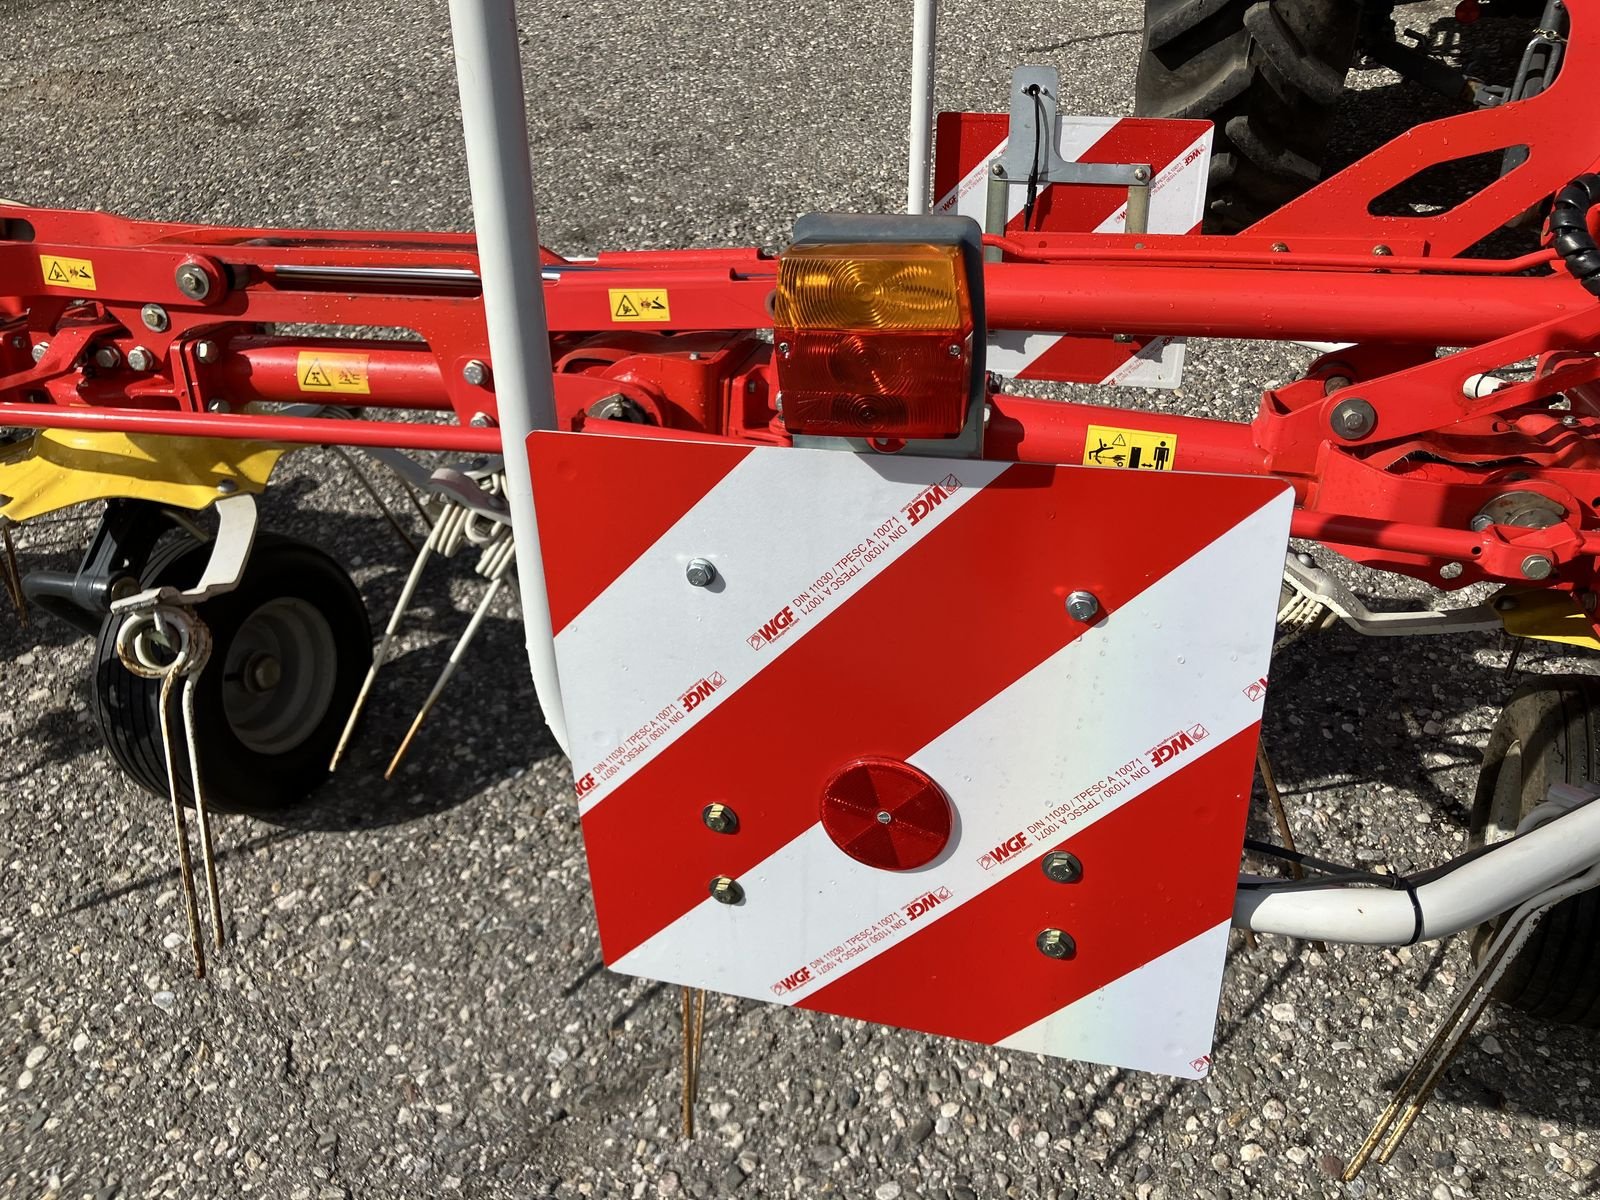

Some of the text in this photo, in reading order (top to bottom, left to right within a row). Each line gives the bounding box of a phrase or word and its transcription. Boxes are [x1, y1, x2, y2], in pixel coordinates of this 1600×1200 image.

[1184, 149, 1201, 166] WGF
[907, 485, 948, 526] WGF
[888, 525, 907, 542] DIN
[864, 541, 889, 562] 11030
[758, 606, 793, 642] WGF
[792, 592, 810, 607] DIN
[809, 572, 833, 593] 11030
[835, 544, 866, 570] TPESC
[866, 538, 875, 547] A
[874, 516, 899, 539] 10071
[830, 565, 862, 590] TPESC
[823, 587, 831, 595] A
[800, 594, 824, 615] 10071
[683, 680, 716, 712] WGF
[668, 711, 684, 725] DIN
[593, 762, 608, 774] DIN
[606, 746, 625, 763] 11030
[626, 725, 652, 746] TPESC
[656, 704, 676, 722] 10071
[649, 723, 670, 740] 11030
[624, 742, 648, 762] TPESC
[1151, 733, 1194, 768] WGF
[600, 765, 620, 780] 10071
[1130, 766, 1150, 781] DIN
[1104, 779, 1130, 798] 11030
[989, 832, 1026, 861] WGF
[1027, 820, 1045, 834] DIN
[1045, 804, 1070, 822] 11030
[1074, 781, 1107, 802] TPESC
[1108, 776, 1116, 784] A
[1115, 758, 1142, 777] 10071
[1067, 799, 1100, 820] TPESC
[1034, 823, 1060, 841] 10071
[907, 894, 941, 921] WGF
[890, 919, 907, 930] DIN
[869, 929, 891, 943] 11030
[781, 967, 810, 990] WGF
[809, 958, 824, 968] DIN
[824, 946, 844, 960] 11030
[846, 929, 872, 946] TPESC
[878, 912, 899, 927] 10071
[842, 943, 868, 960] TPESC
[816, 962, 836, 975] 10071
